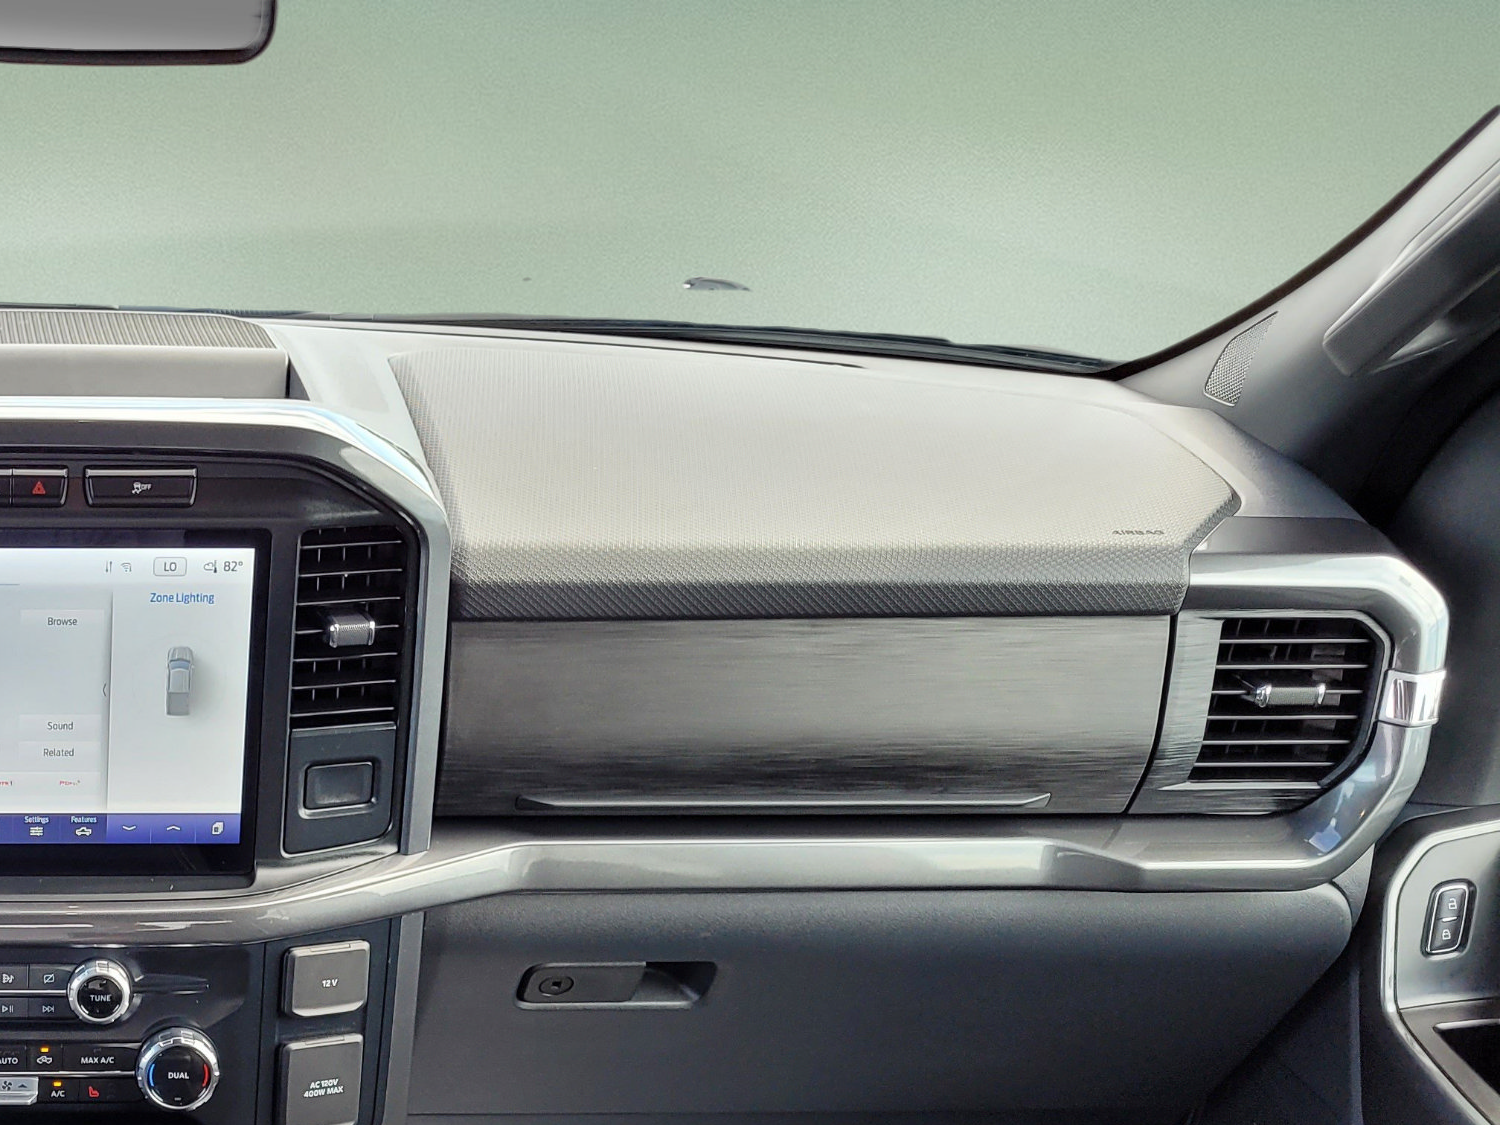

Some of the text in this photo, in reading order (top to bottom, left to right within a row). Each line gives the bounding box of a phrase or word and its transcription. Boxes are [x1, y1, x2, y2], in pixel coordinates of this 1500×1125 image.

[163, 561, 177, 572] LO
[223, 560, 244, 573] 82°
[150, 592, 215, 605] Zone Lighting
[47, 617, 78, 627] Browse
[47, 721, 74, 731] Sound
[43, 747, 75, 757] Related
[24, 816, 49, 824] Settings
[70, 816, 97, 824] Features
[322, 980, 331, 988] 12
[90, 994, 111, 1003] TUNE
[81, 1056, 115, 1065] MAX A/C
[168, 1071, 189, 1080] DUAL
[321, 1078, 339, 1087] 120V
[51, 1090, 65, 1098] A/C
[303, 1085, 344, 1098] 400W MAX
